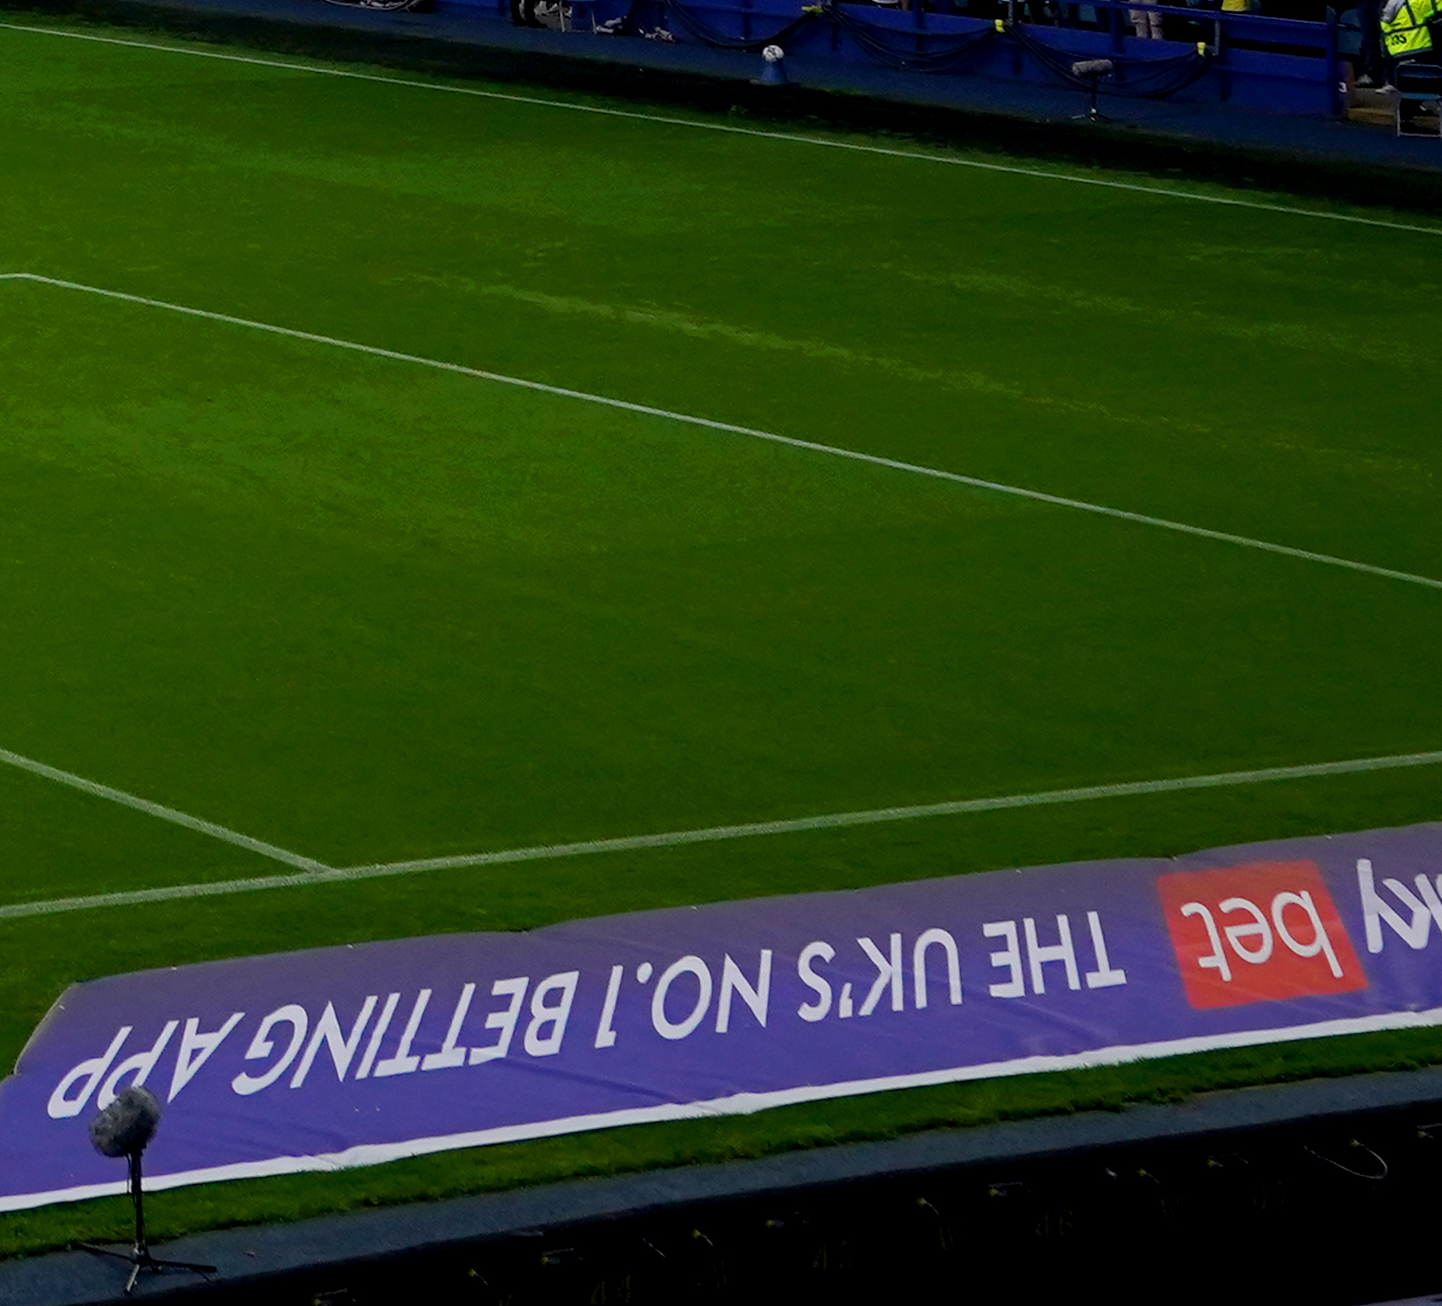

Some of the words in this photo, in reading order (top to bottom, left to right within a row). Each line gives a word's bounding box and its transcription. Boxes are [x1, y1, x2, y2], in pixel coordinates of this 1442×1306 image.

[987, 909, 1129, 997] THE
[1190, 890, 1355, 983] bet
[1356, 859, 1442, 955] ky
[796, 926, 964, 1023] UK'S
[46, 1011, 247, 1120] APP
[230, 971, 580, 1096] BETTING
